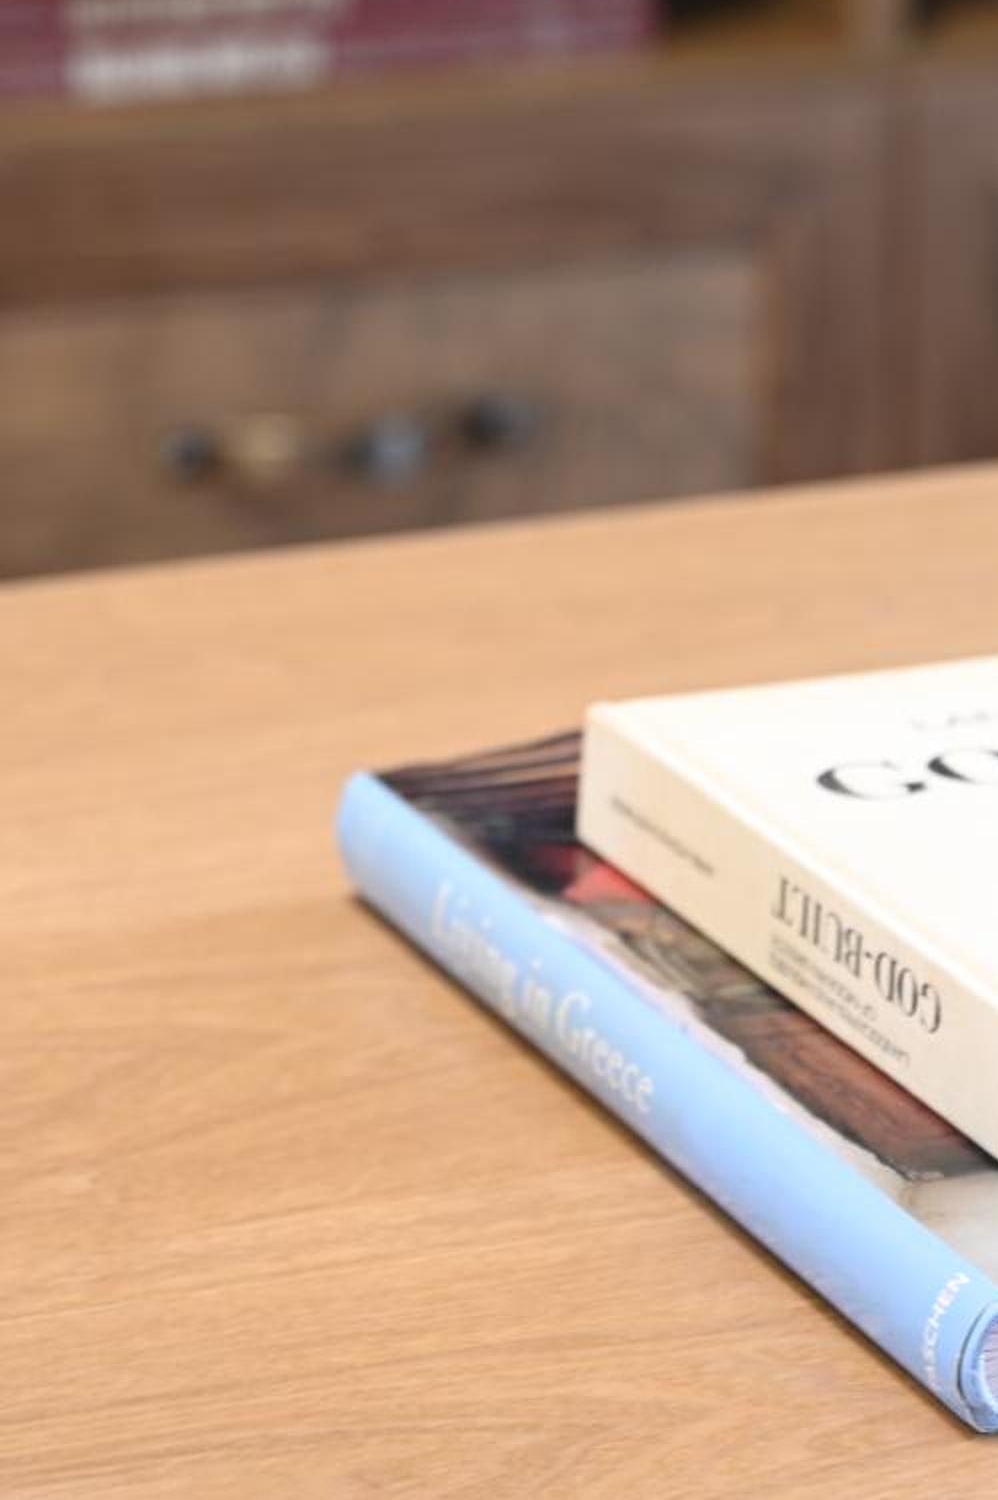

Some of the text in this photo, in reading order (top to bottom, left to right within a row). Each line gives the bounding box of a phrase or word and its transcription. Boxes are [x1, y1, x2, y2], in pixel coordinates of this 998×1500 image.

[769, 876, 942, 1036] GOD-BUILT
[555, 988, 656, 1114] Greece
[923, 1272, 970, 1389] SCHEN
